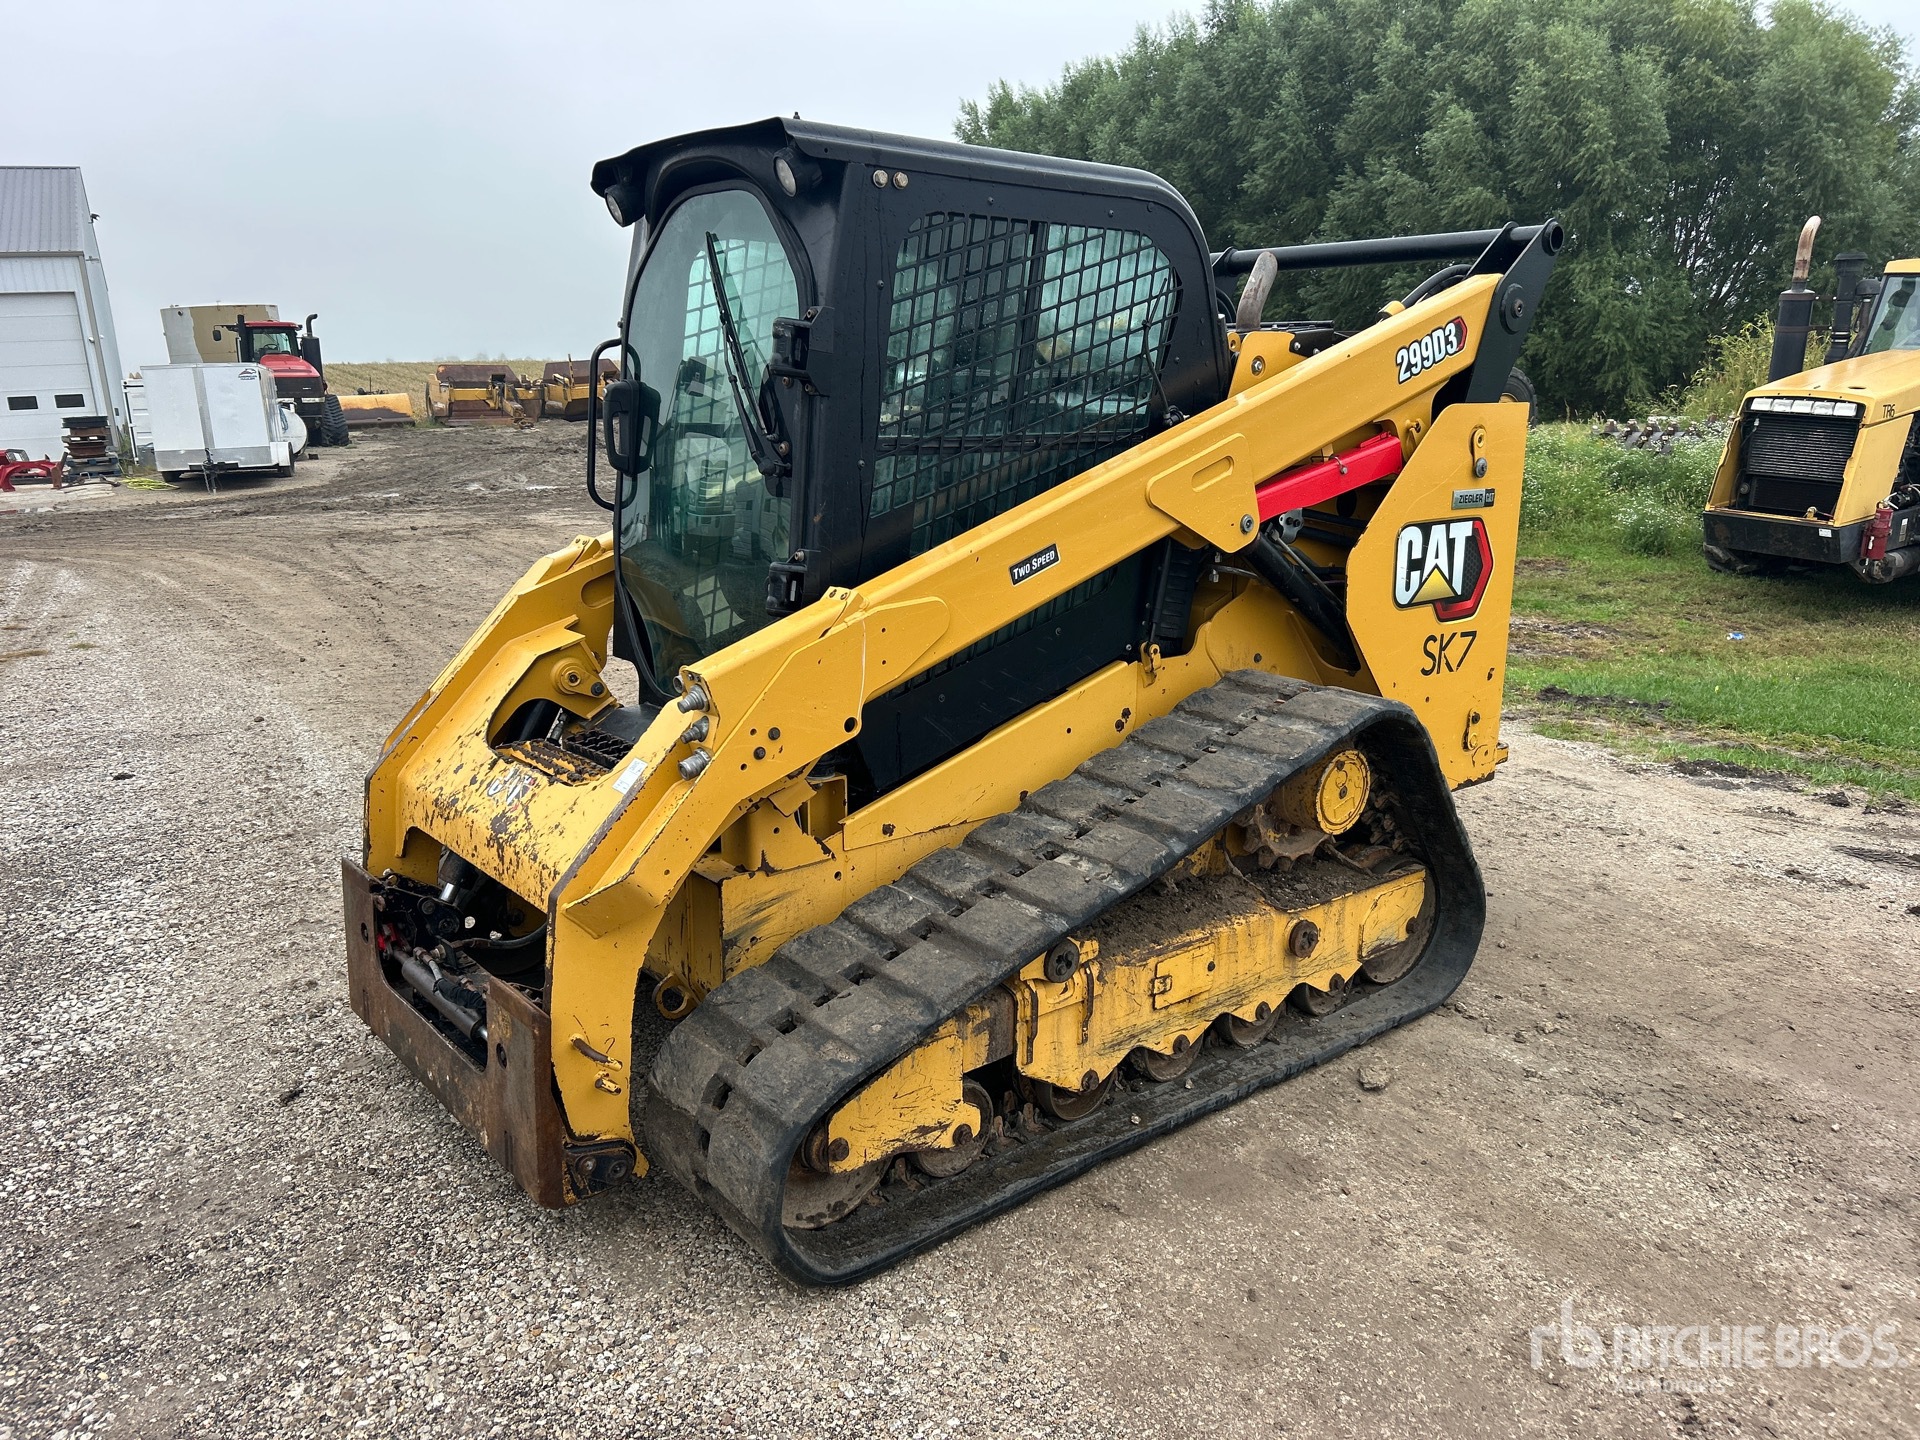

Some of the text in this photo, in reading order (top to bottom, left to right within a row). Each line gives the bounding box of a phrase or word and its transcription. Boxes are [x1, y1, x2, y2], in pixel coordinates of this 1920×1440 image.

[1396, 322, 1458, 382] 299D3
[1883, 404, 1896, 418] TR6
[1458, 493, 1484, 504] ZIEGLER
[1013, 551, 1055, 579] TWO SPEED
[1395, 520, 1474, 606] CAT
[1420, 630, 1478, 677] SK7
